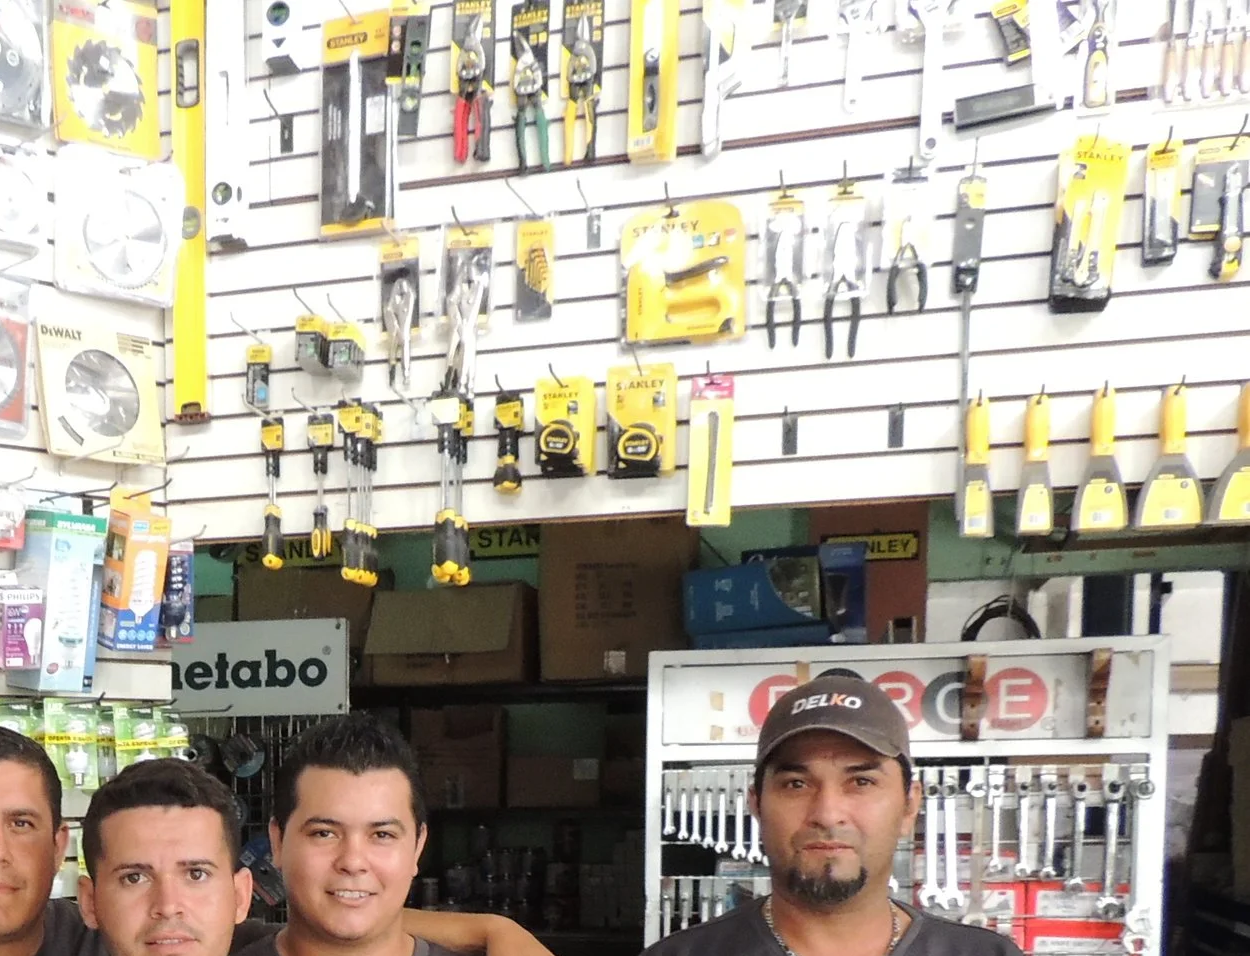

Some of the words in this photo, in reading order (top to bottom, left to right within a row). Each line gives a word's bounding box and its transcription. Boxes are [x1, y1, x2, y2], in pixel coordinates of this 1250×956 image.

[328, 33, 366, 48] STANLEY
[1077, 151, 1124, 161] STANLEY
[616, 380, 665, 390] STANLEY
[543, 392, 579, 400] STANLEY
[478, 527, 541, 549] STAN
[866, 538, 910, 553] NLEY
[246, 537, 343, 561] SANLY
[791, 692, 862, 716] DELKO
